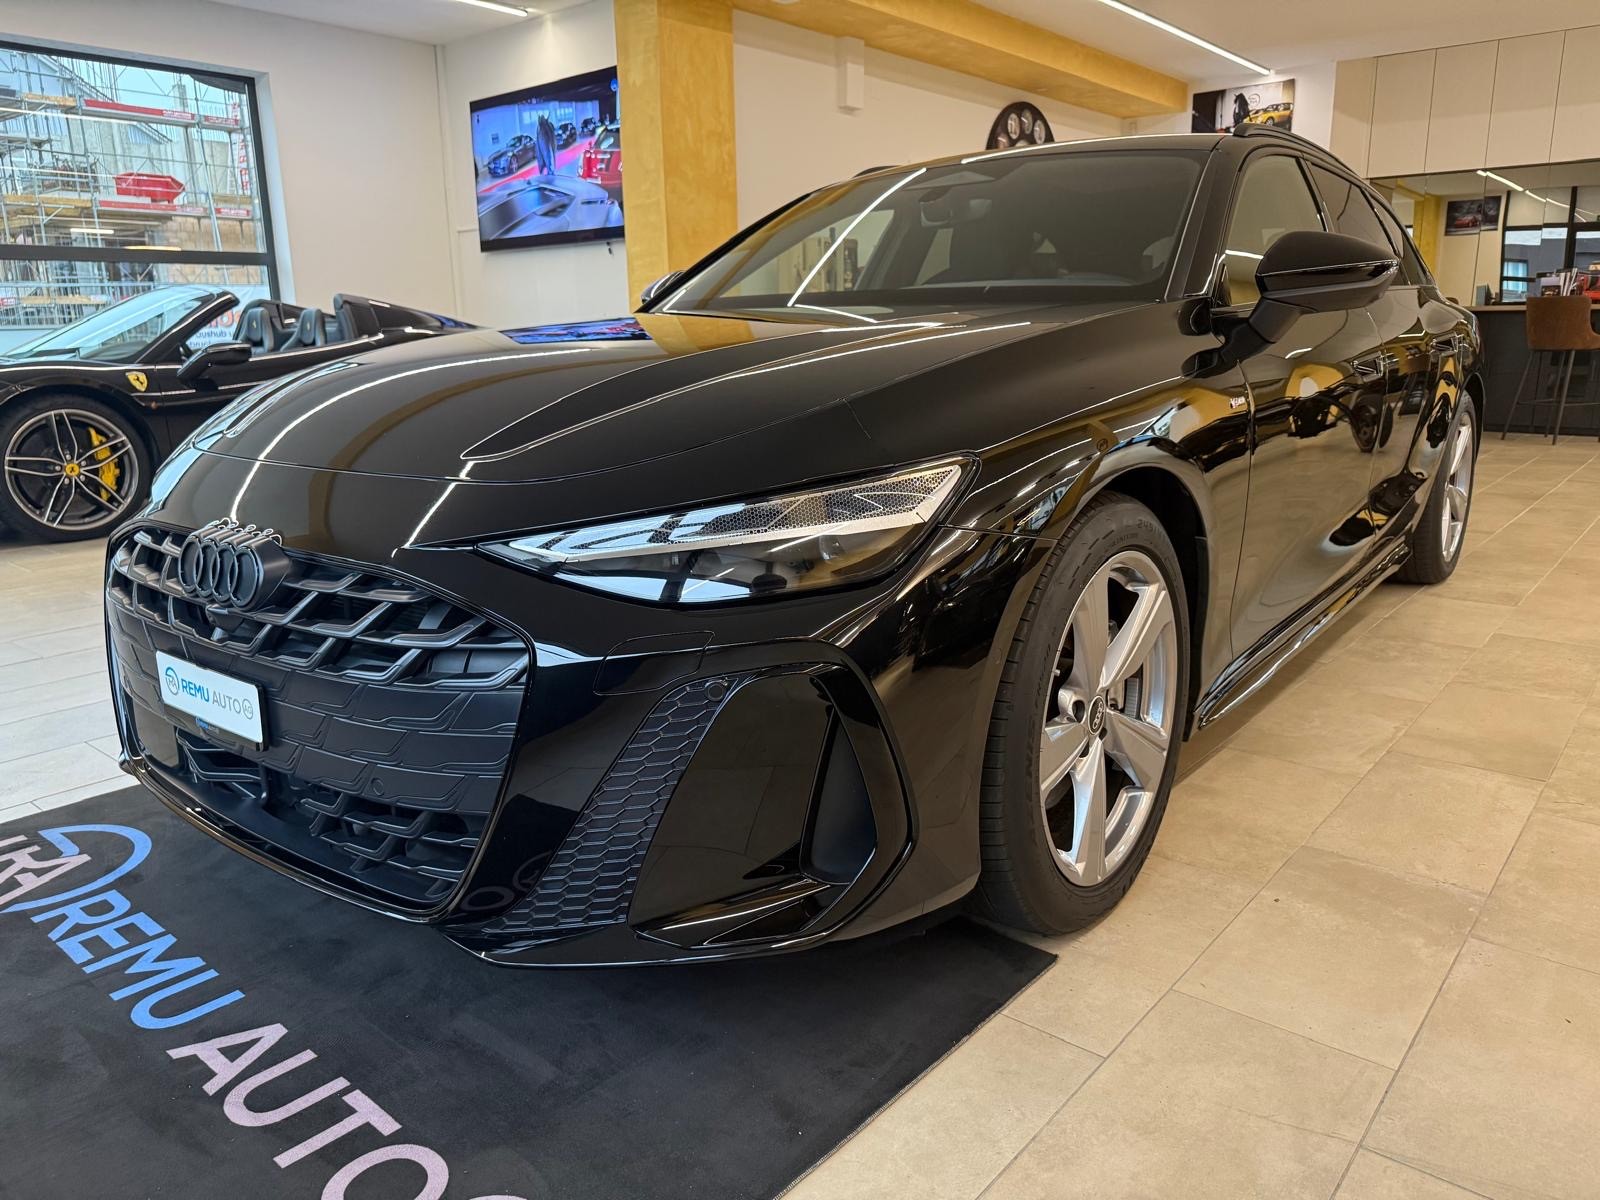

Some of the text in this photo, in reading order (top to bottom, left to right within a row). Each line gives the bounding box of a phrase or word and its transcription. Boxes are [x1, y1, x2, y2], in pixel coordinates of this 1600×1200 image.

[181, 678, 210, 703] REMU
[212, 690, 242, 714] AUTO
[30, 889, 246, 1030] REMU
[166, 1023, 450, 1200] AUTO
